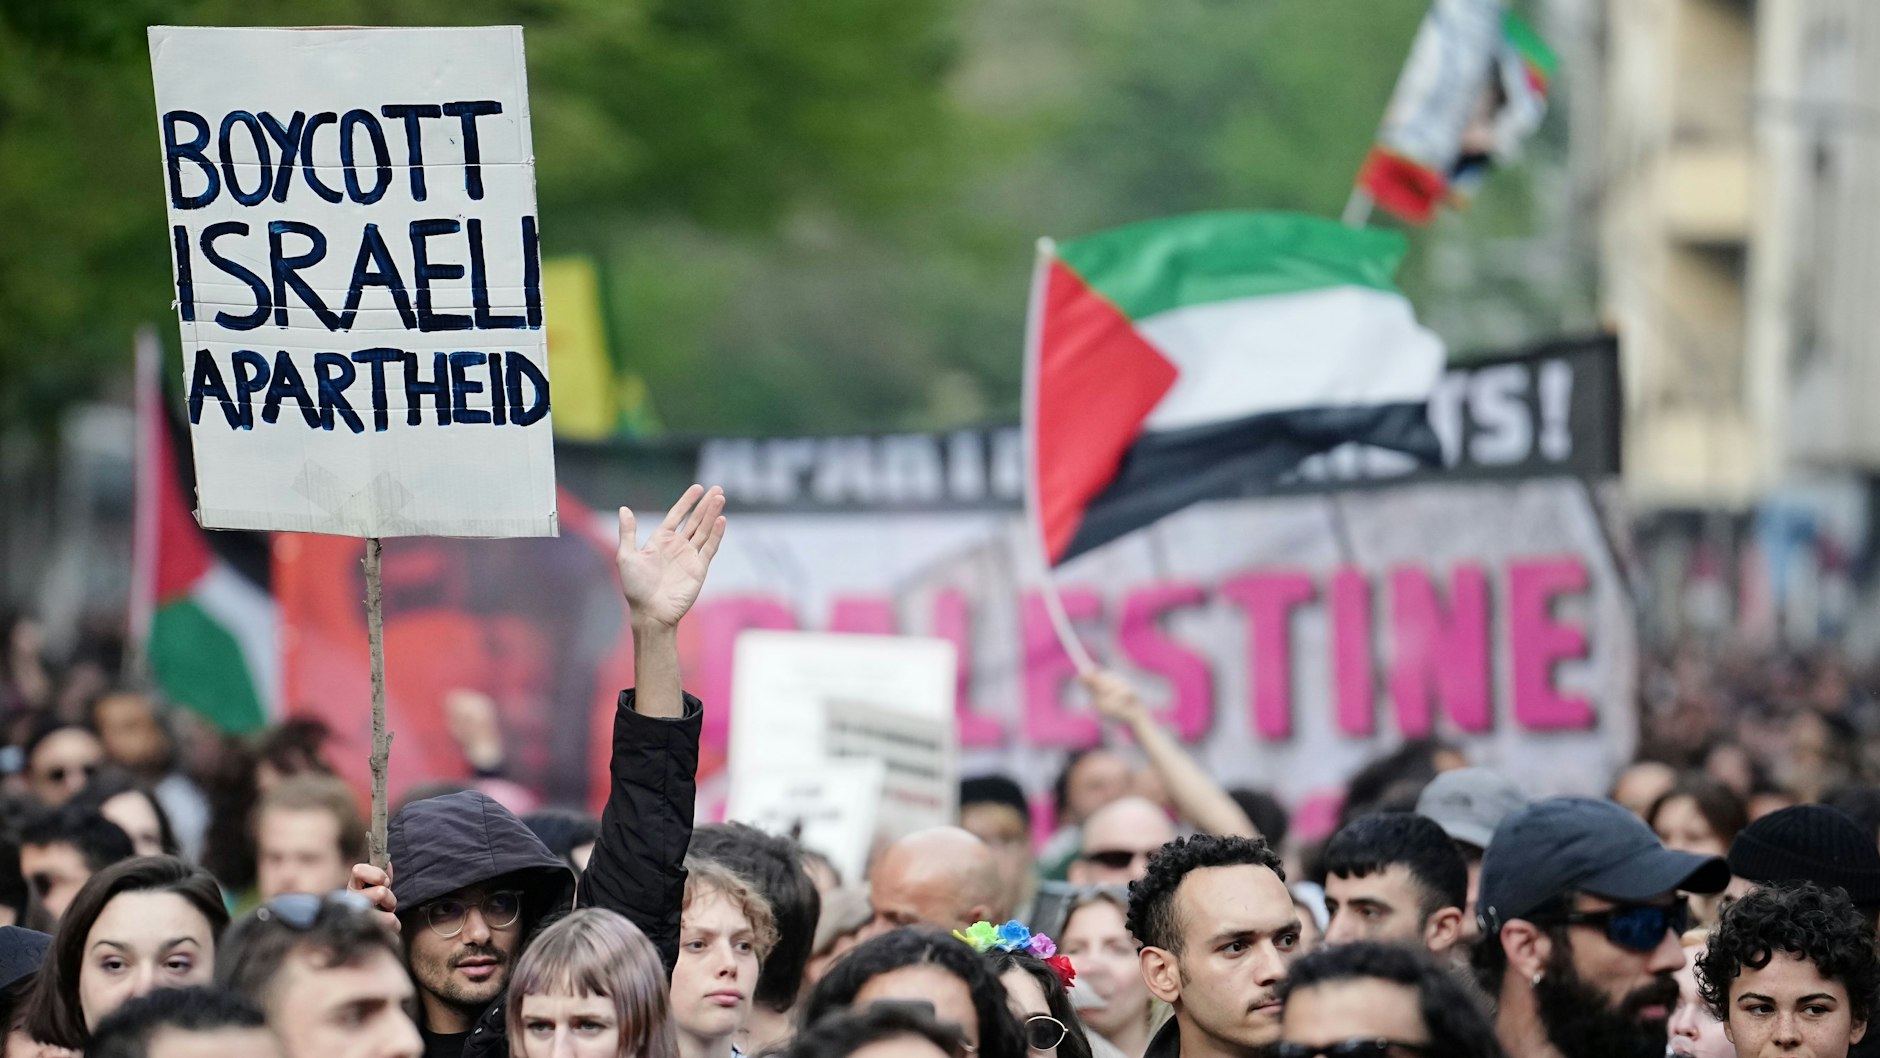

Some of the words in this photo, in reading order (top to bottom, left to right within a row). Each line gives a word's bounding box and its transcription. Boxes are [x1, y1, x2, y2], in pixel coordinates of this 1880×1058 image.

[163, 101, 502, 210] BOYCOTT
[174, 216, 542, 331] ISRAELI
[190, 348, 551, 434] APARTHEID
[699, 556, 1595, 747] PLESTINE
